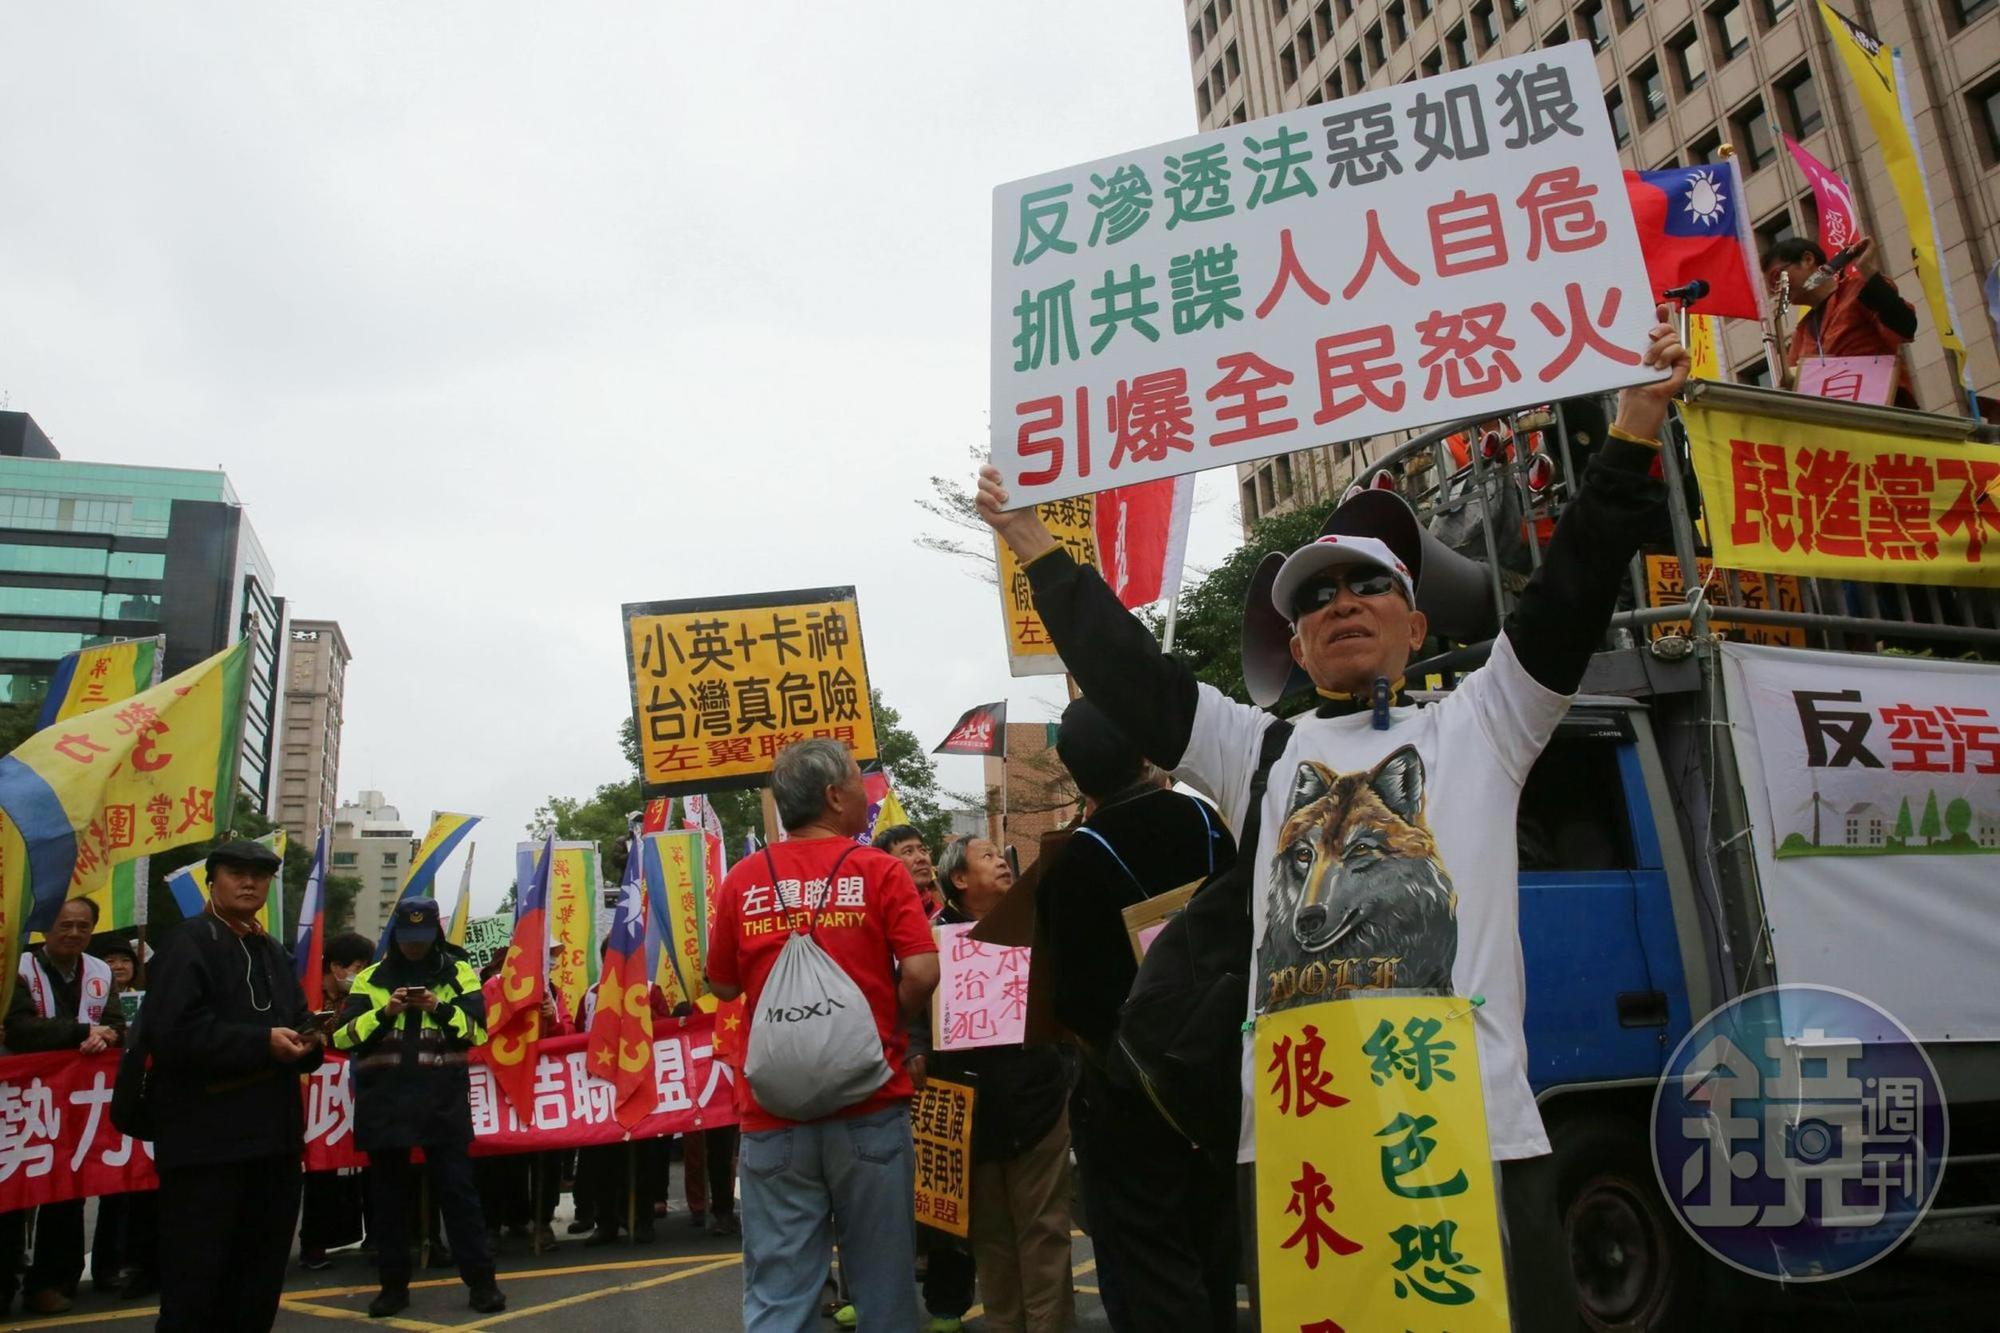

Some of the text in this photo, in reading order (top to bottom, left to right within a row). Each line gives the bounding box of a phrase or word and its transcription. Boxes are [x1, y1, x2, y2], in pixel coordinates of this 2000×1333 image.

[1012, 62, 1584, 266] 反滲透法惡如狼
[1012, 166, 1608, 372] 抓共諜人人自危
[1016, 282, 1642, 486] 引爆全民怒火
[1729, 438, 2000, 563] 民進黨不
[640, 606, 849, 678] 小英+卡神
[1015, 615, 1054, 646] 左
[645, 665, 862, 742] 台灣真危險
[742, 876, 867, 916] 左翼聯盟
[742, 911, 866, 937] THE LEFT PARTY
[1361, 1016, 1483, 1333] 綠色恐
